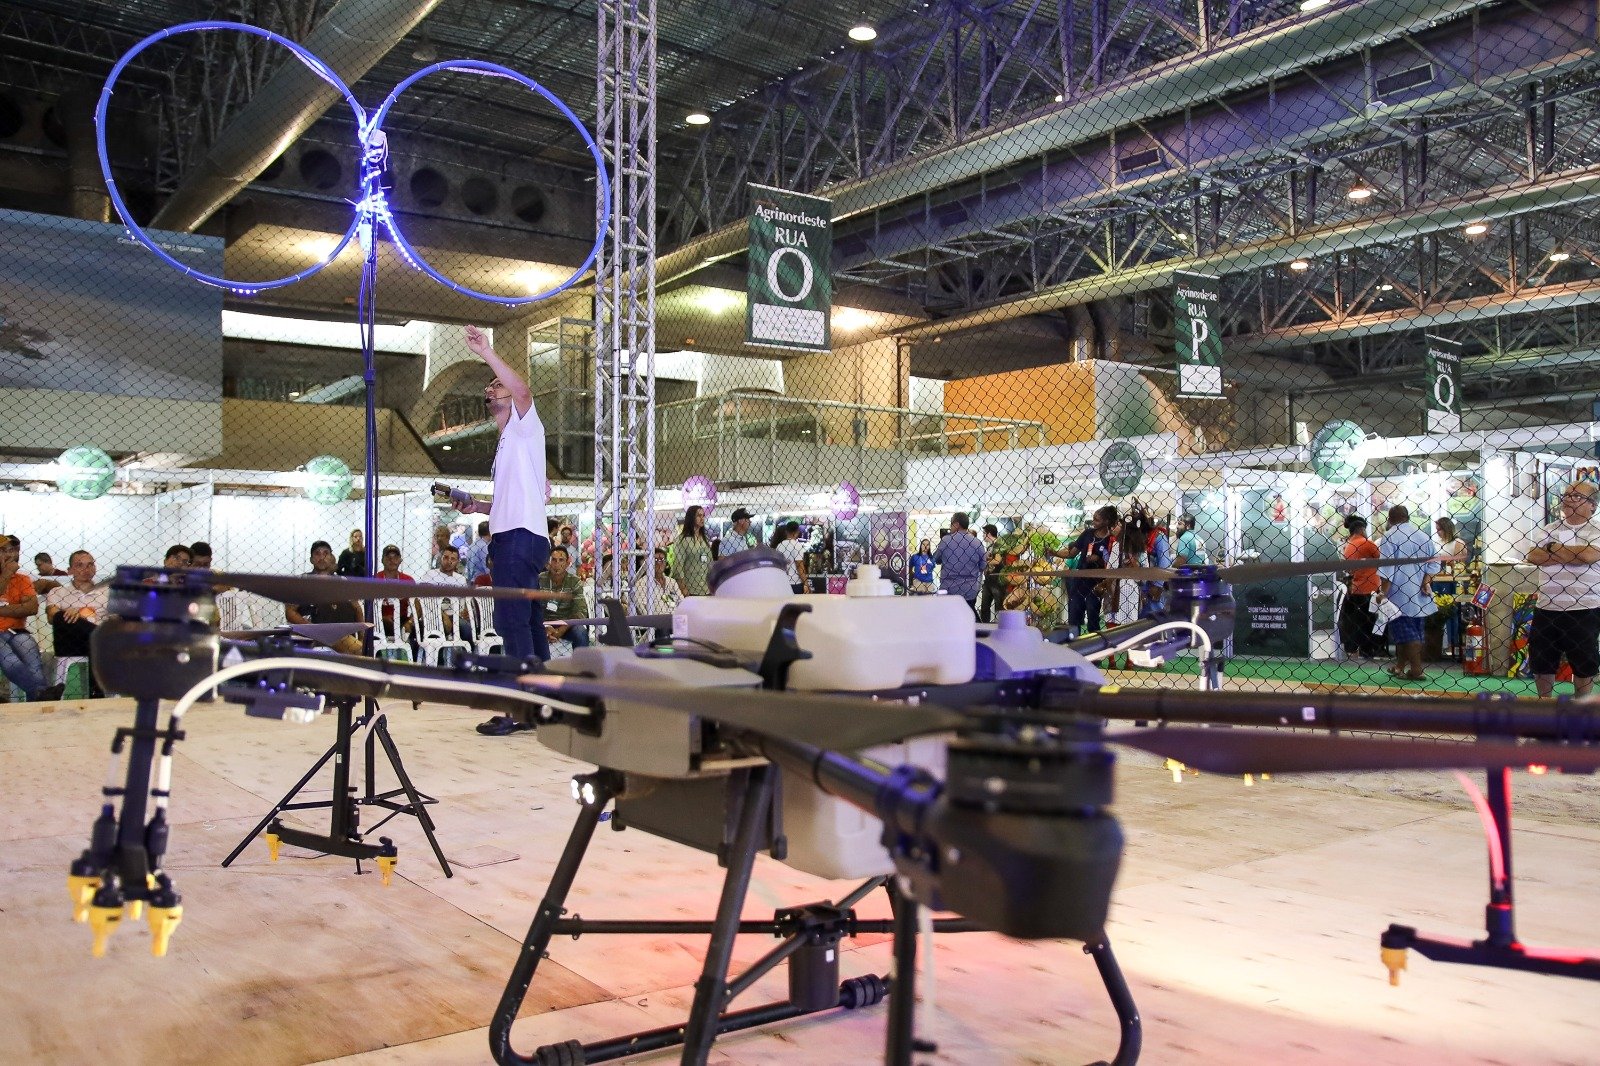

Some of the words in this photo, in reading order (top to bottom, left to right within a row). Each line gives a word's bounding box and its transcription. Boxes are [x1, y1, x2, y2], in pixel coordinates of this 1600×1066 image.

[754, 205, 827, 228] Agrinordeste
[774, 227, 808, 248] RUA
[767, 247, 814, 302] O
[1187, 303, 1207, 318] RUA
[1190, 318, 1209, 360] P
[1437, 361, 1452, 374] RUA
[1434, 374, 1455, 414] Q
